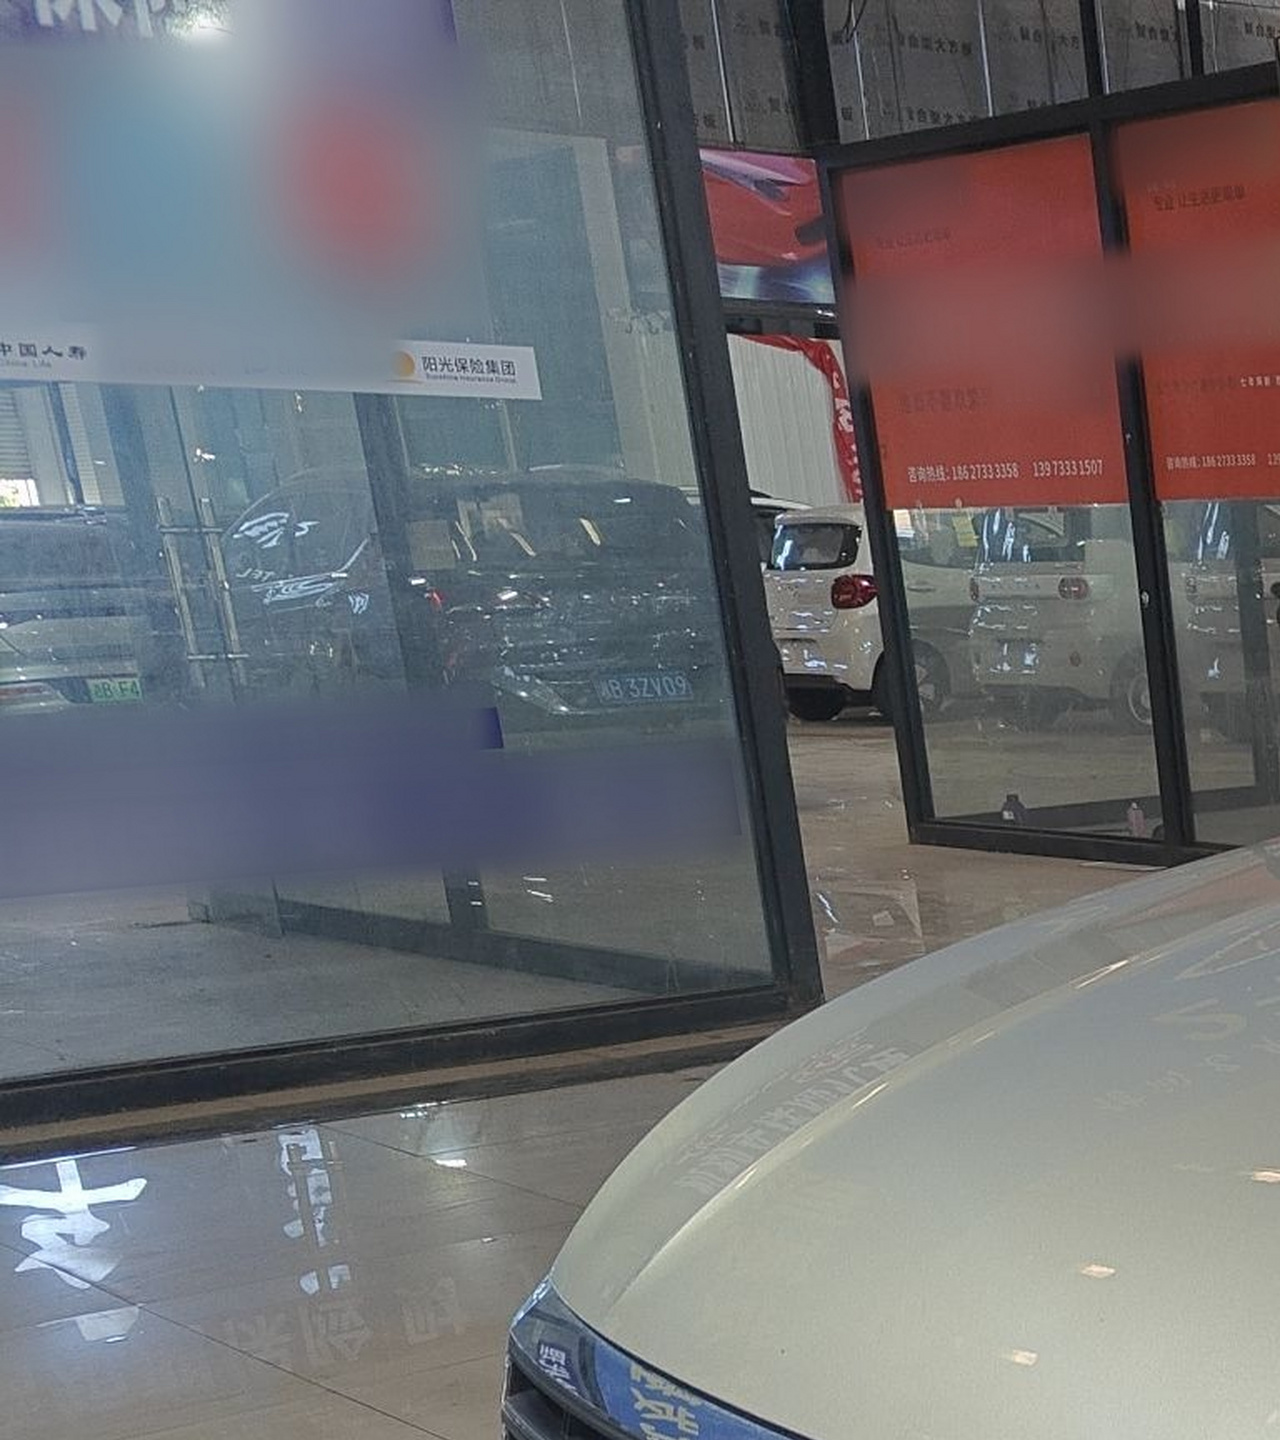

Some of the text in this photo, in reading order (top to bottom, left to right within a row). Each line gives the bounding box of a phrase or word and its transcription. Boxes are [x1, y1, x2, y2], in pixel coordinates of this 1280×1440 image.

[420, 355, 516, 377] 阳光保险集团
